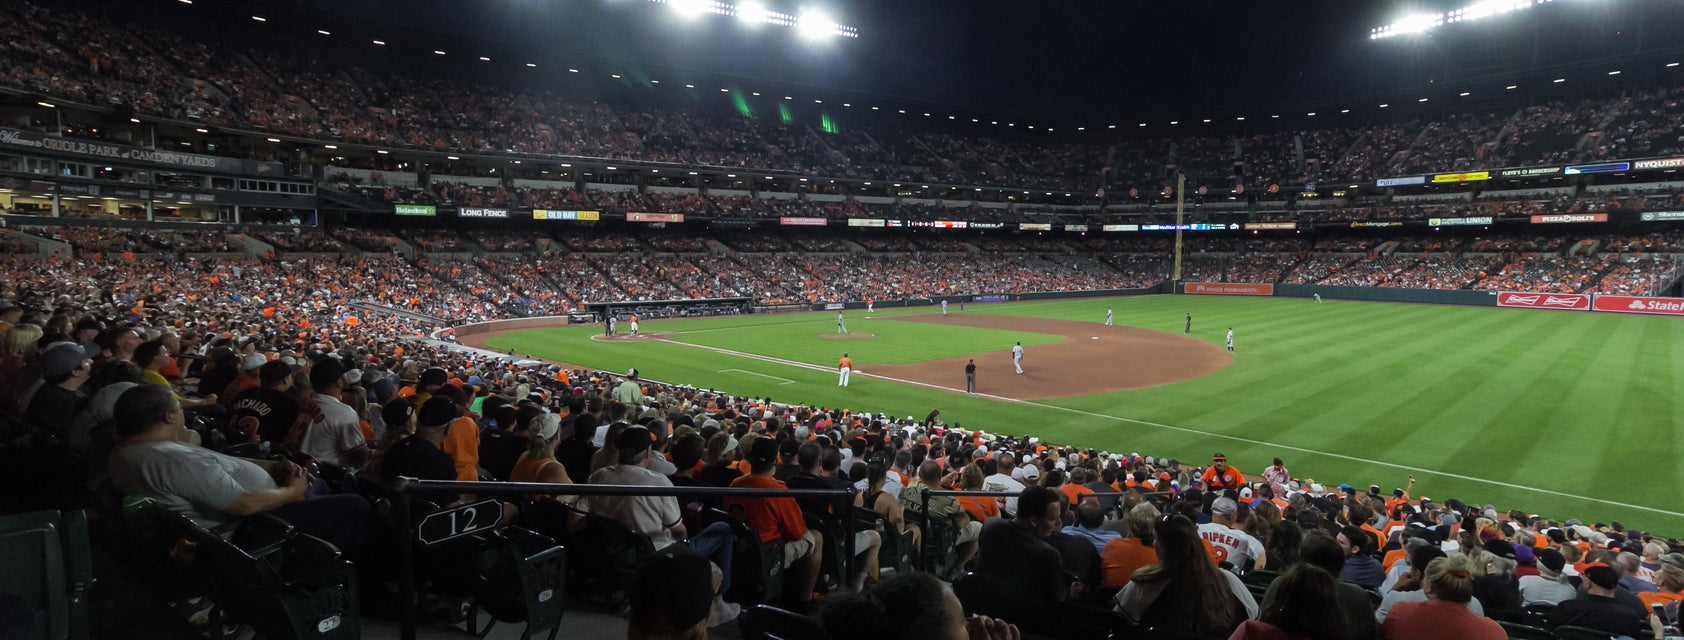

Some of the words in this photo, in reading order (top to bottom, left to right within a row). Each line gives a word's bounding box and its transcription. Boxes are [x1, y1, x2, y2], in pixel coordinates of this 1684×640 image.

[42, 138, 87, 154] ORIOLE
[88, 144, 120, 157] PARK
[131, 150, 180, 164] CAMDEN
[180, 155, 216, 168] YARDS
[1635, 160, 1682, 168] NYQUIST
[548, 210, 562, 218] OLD
[1647, 300, 1679, 310] State
[450, 507, 478, 536] 12
[1202, 532, 1240, 549] RIPKEN
[322, 618, 336, 630] 27
